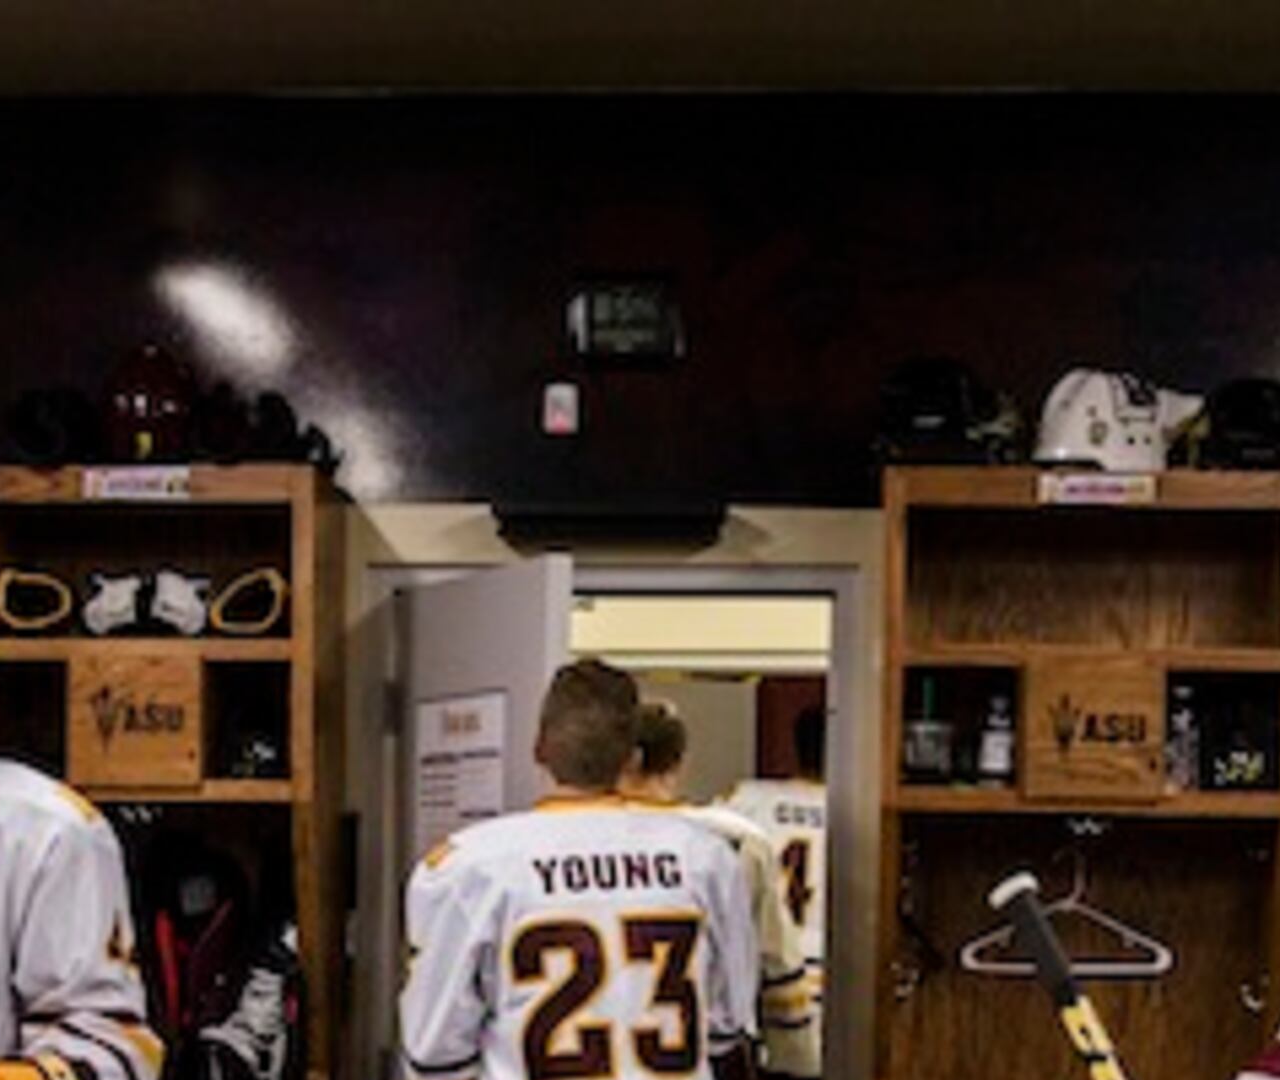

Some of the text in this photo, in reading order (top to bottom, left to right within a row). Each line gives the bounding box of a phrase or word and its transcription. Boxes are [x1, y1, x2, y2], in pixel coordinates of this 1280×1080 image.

[124, 702, 185, 732] ASU
[1082, 711, 1147, 745] ASU
[532, 853, 682, 895] YOUNG
